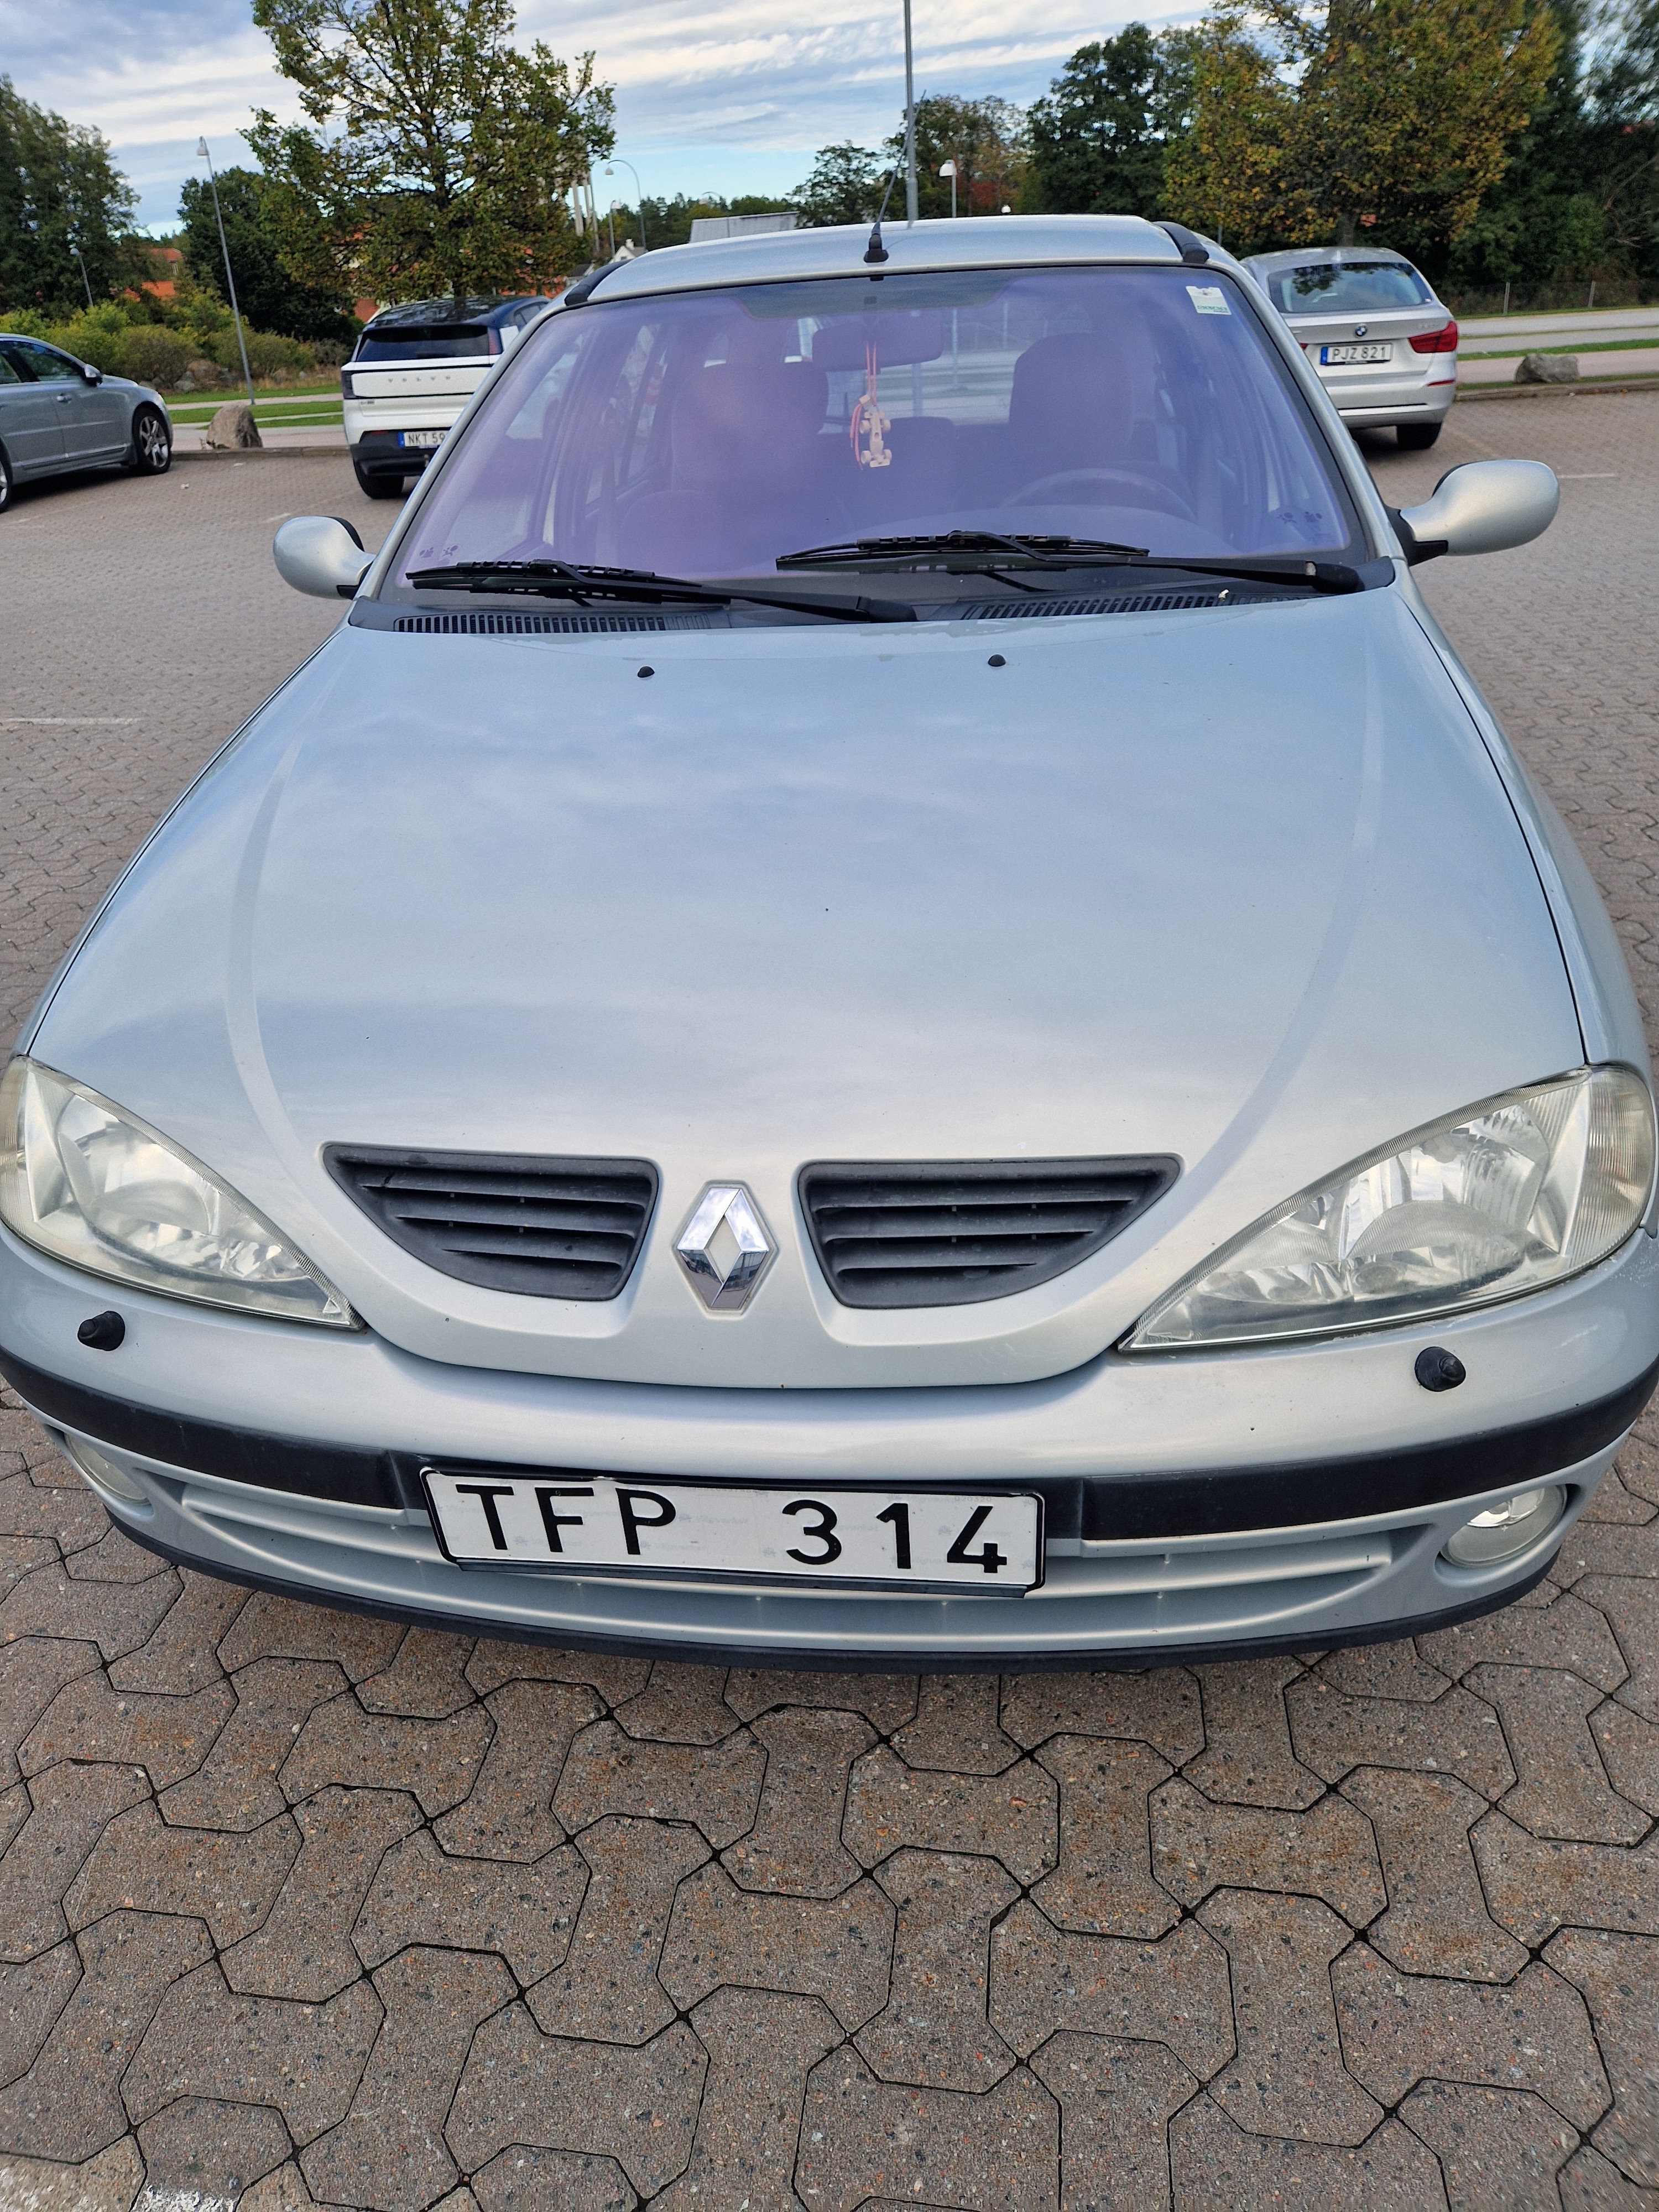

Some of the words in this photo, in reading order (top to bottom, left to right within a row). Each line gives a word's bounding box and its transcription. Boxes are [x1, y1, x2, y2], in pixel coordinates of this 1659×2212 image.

[1332, 347, 1358, 360] PJZ
[1360, 346, 1386, 359] 821
[408, 433, 428, 445] NKT
[455, 1484, 676, 1555] TFP
[781, 1499, 1008, 1573] 314
